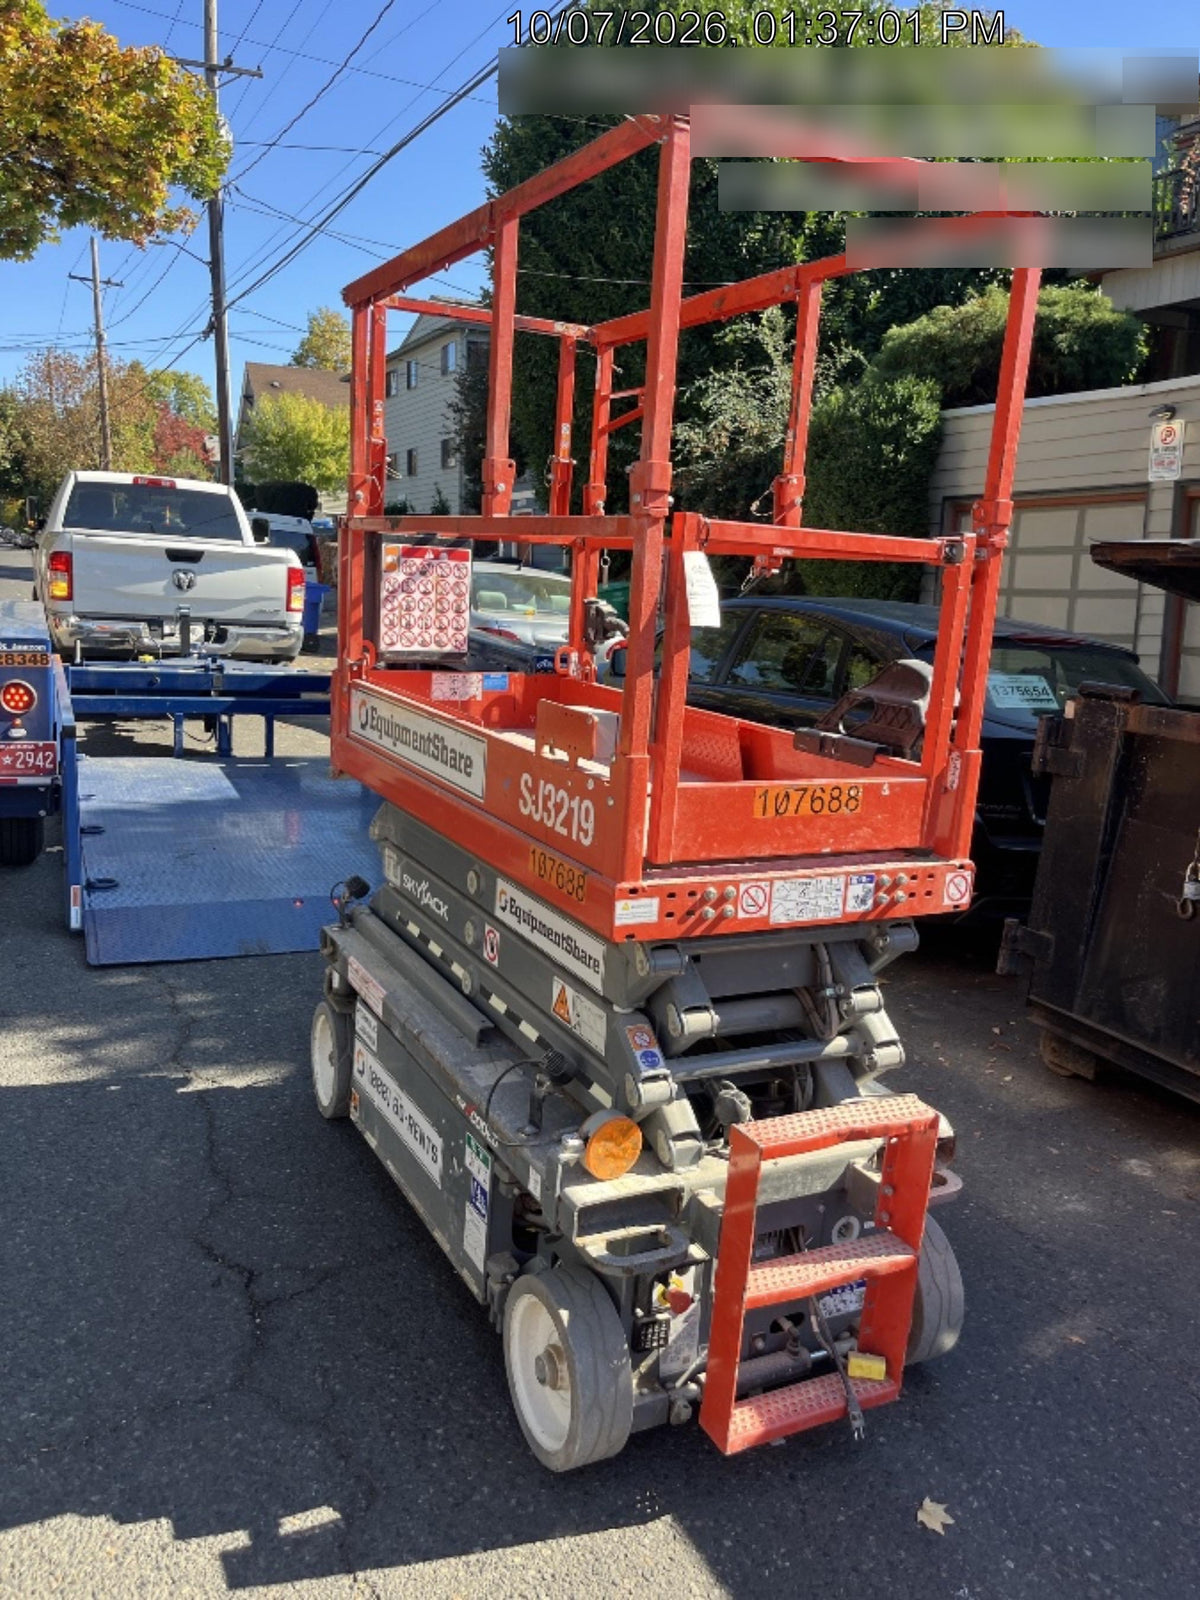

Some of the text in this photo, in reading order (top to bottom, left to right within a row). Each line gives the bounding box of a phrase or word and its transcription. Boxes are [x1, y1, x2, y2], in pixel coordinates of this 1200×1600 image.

[15, 751, 54, 769] 2942
[370, 705, 473, 778] EquipmentShare
[518, 772, 595, 847] SJ3219
[758, 785, 860, 817] 107688
[402, 873, 449, 922] SKYJACK
[530, 848, 586, 902] 107688
[509, 896, 600, 975] EquipmentShare
